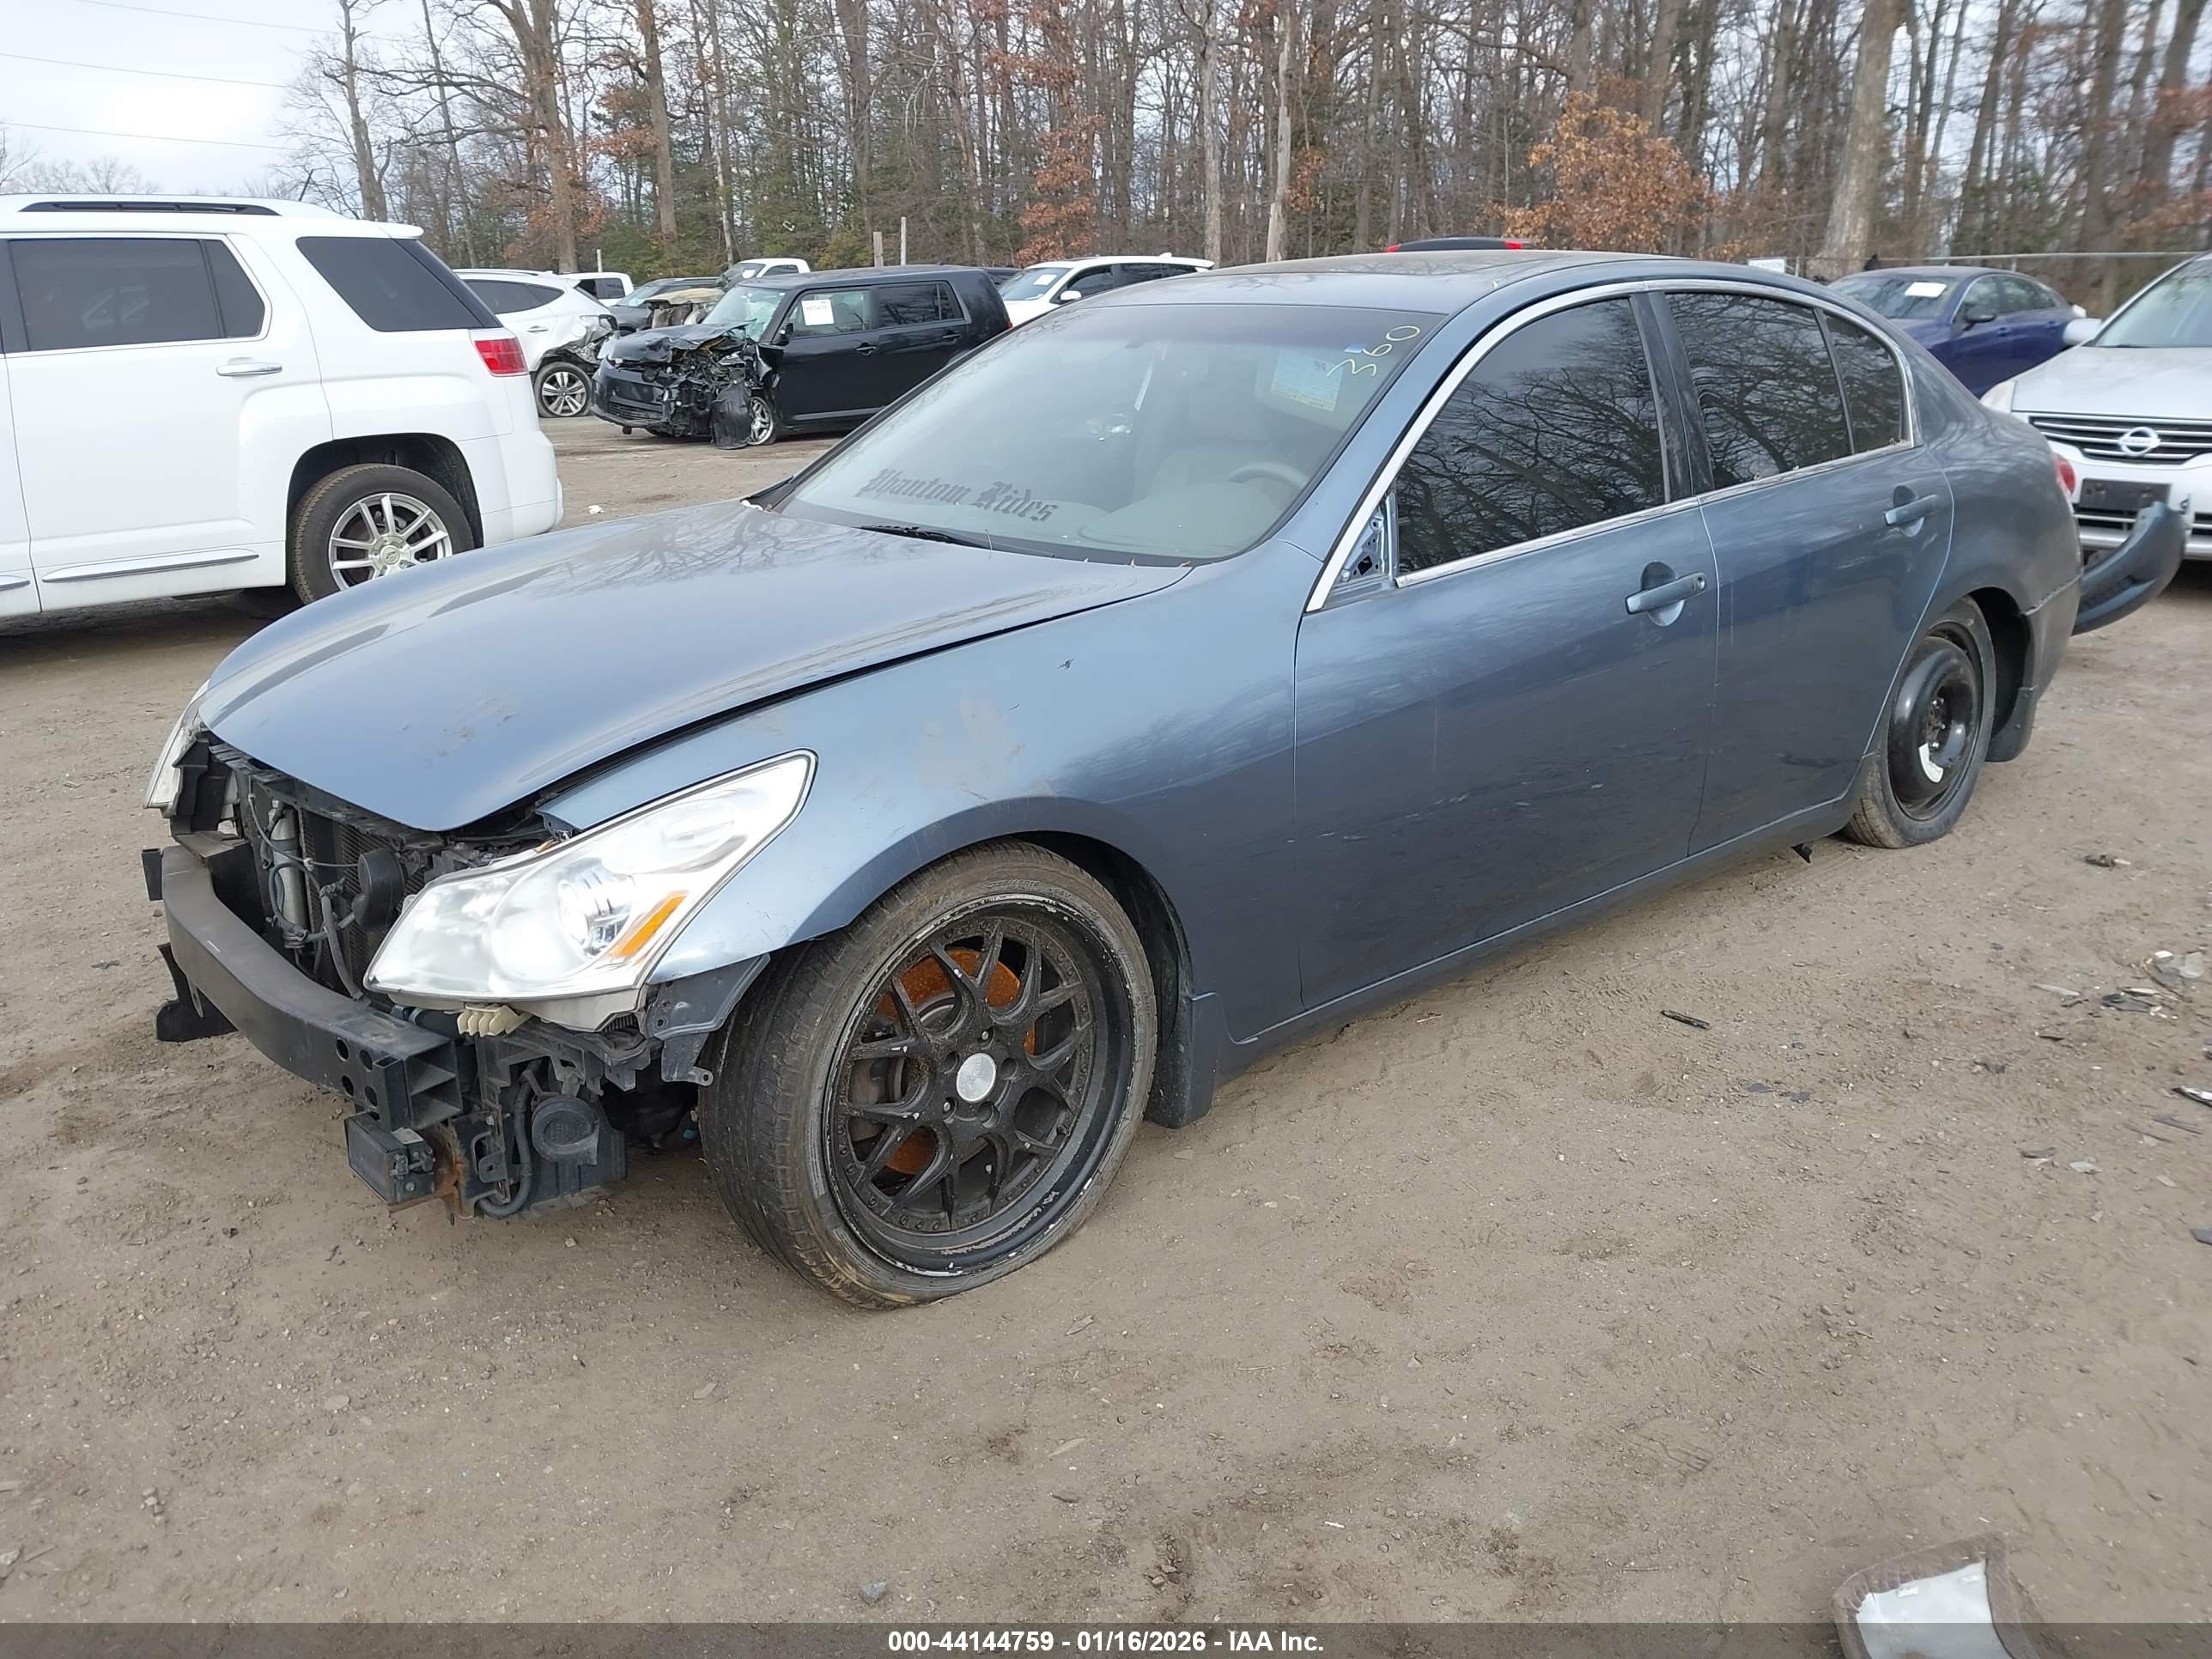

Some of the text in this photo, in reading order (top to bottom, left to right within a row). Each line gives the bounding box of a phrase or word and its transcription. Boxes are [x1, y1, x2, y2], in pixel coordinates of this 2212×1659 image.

[1326, 325, 1421, 377] 360
[854, 467, 1059, 522] Phantom Rides
